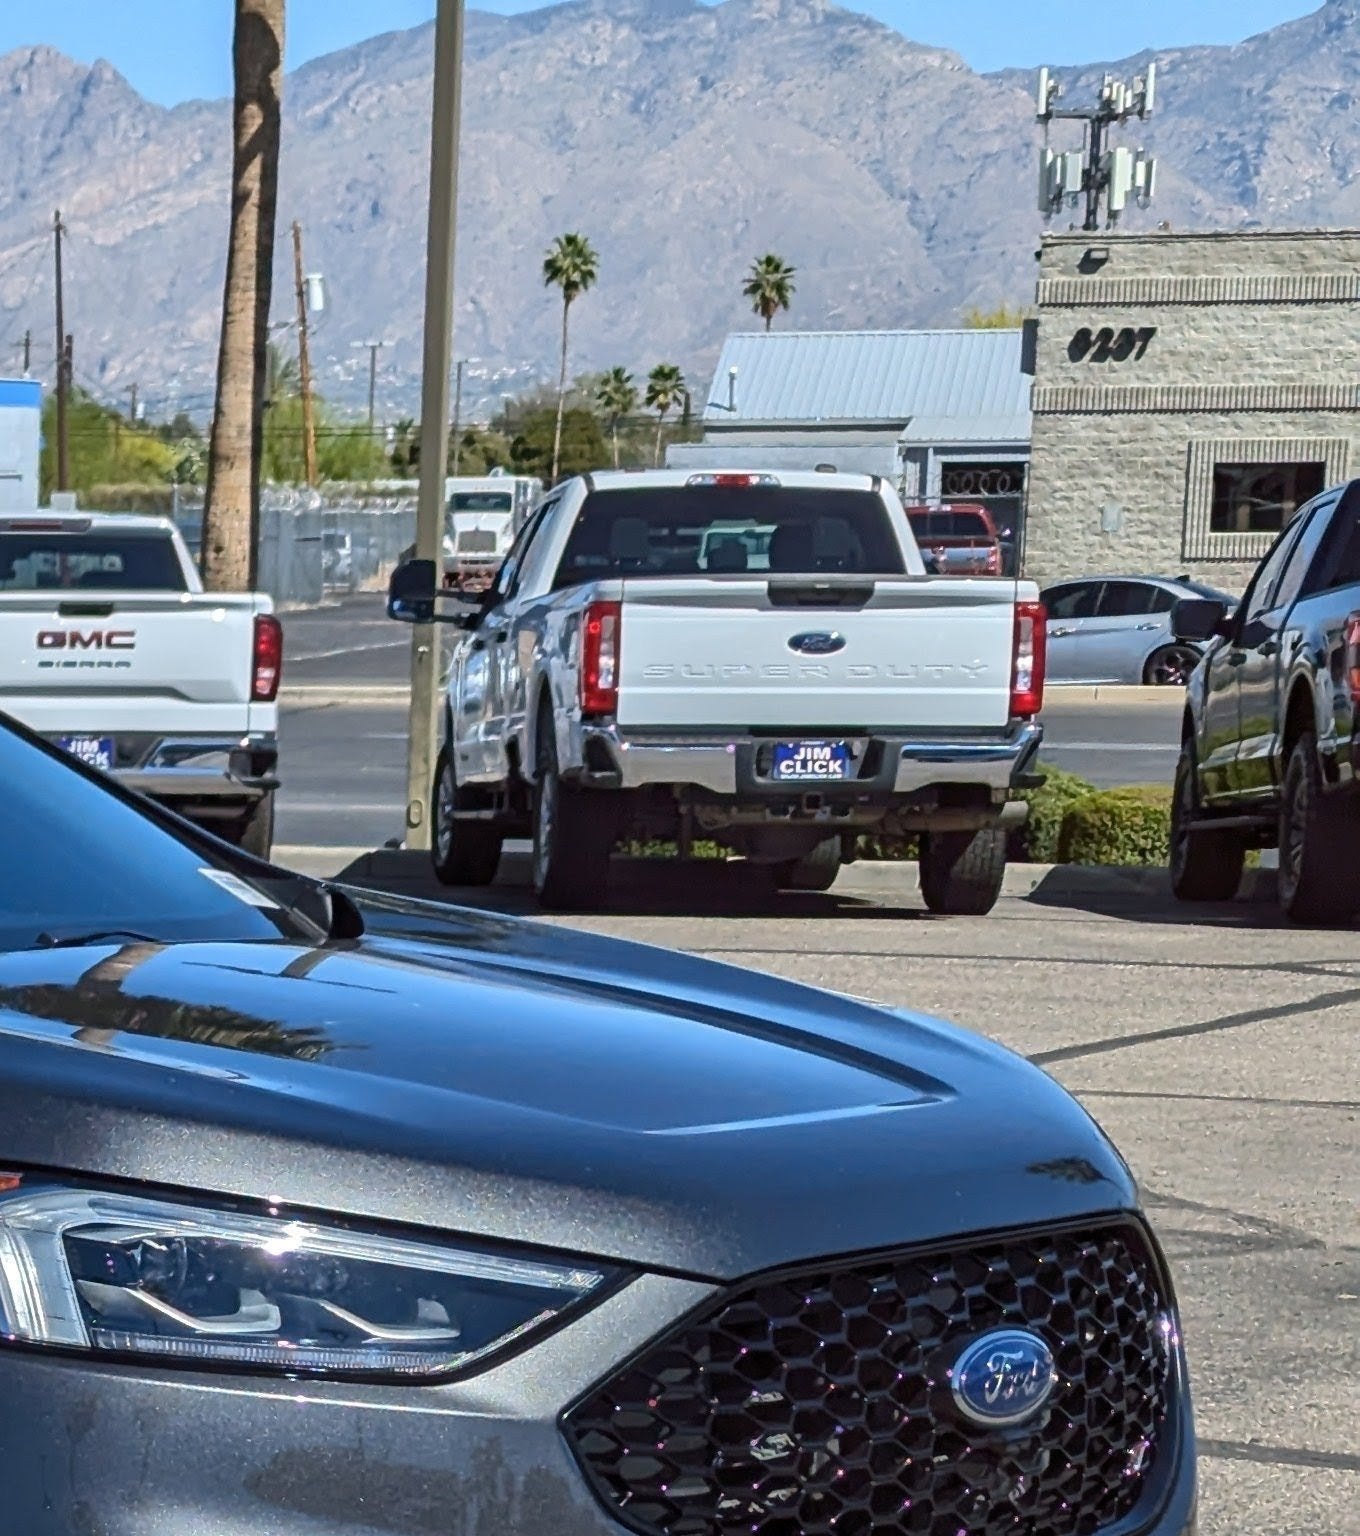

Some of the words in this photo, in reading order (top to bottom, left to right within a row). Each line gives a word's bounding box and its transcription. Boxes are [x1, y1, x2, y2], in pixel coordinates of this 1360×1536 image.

[37, 631, 135, 649] GMC
[643, 664, 829, 679] SUPER
[846, 664, 989, 679] DUTY
[66, 740, 99, 753] JIM
[793, 747, 831, 760] JIM
[779, 760, 843, 774] CLICK
[984, 1350, 1039, 1404] Ford
